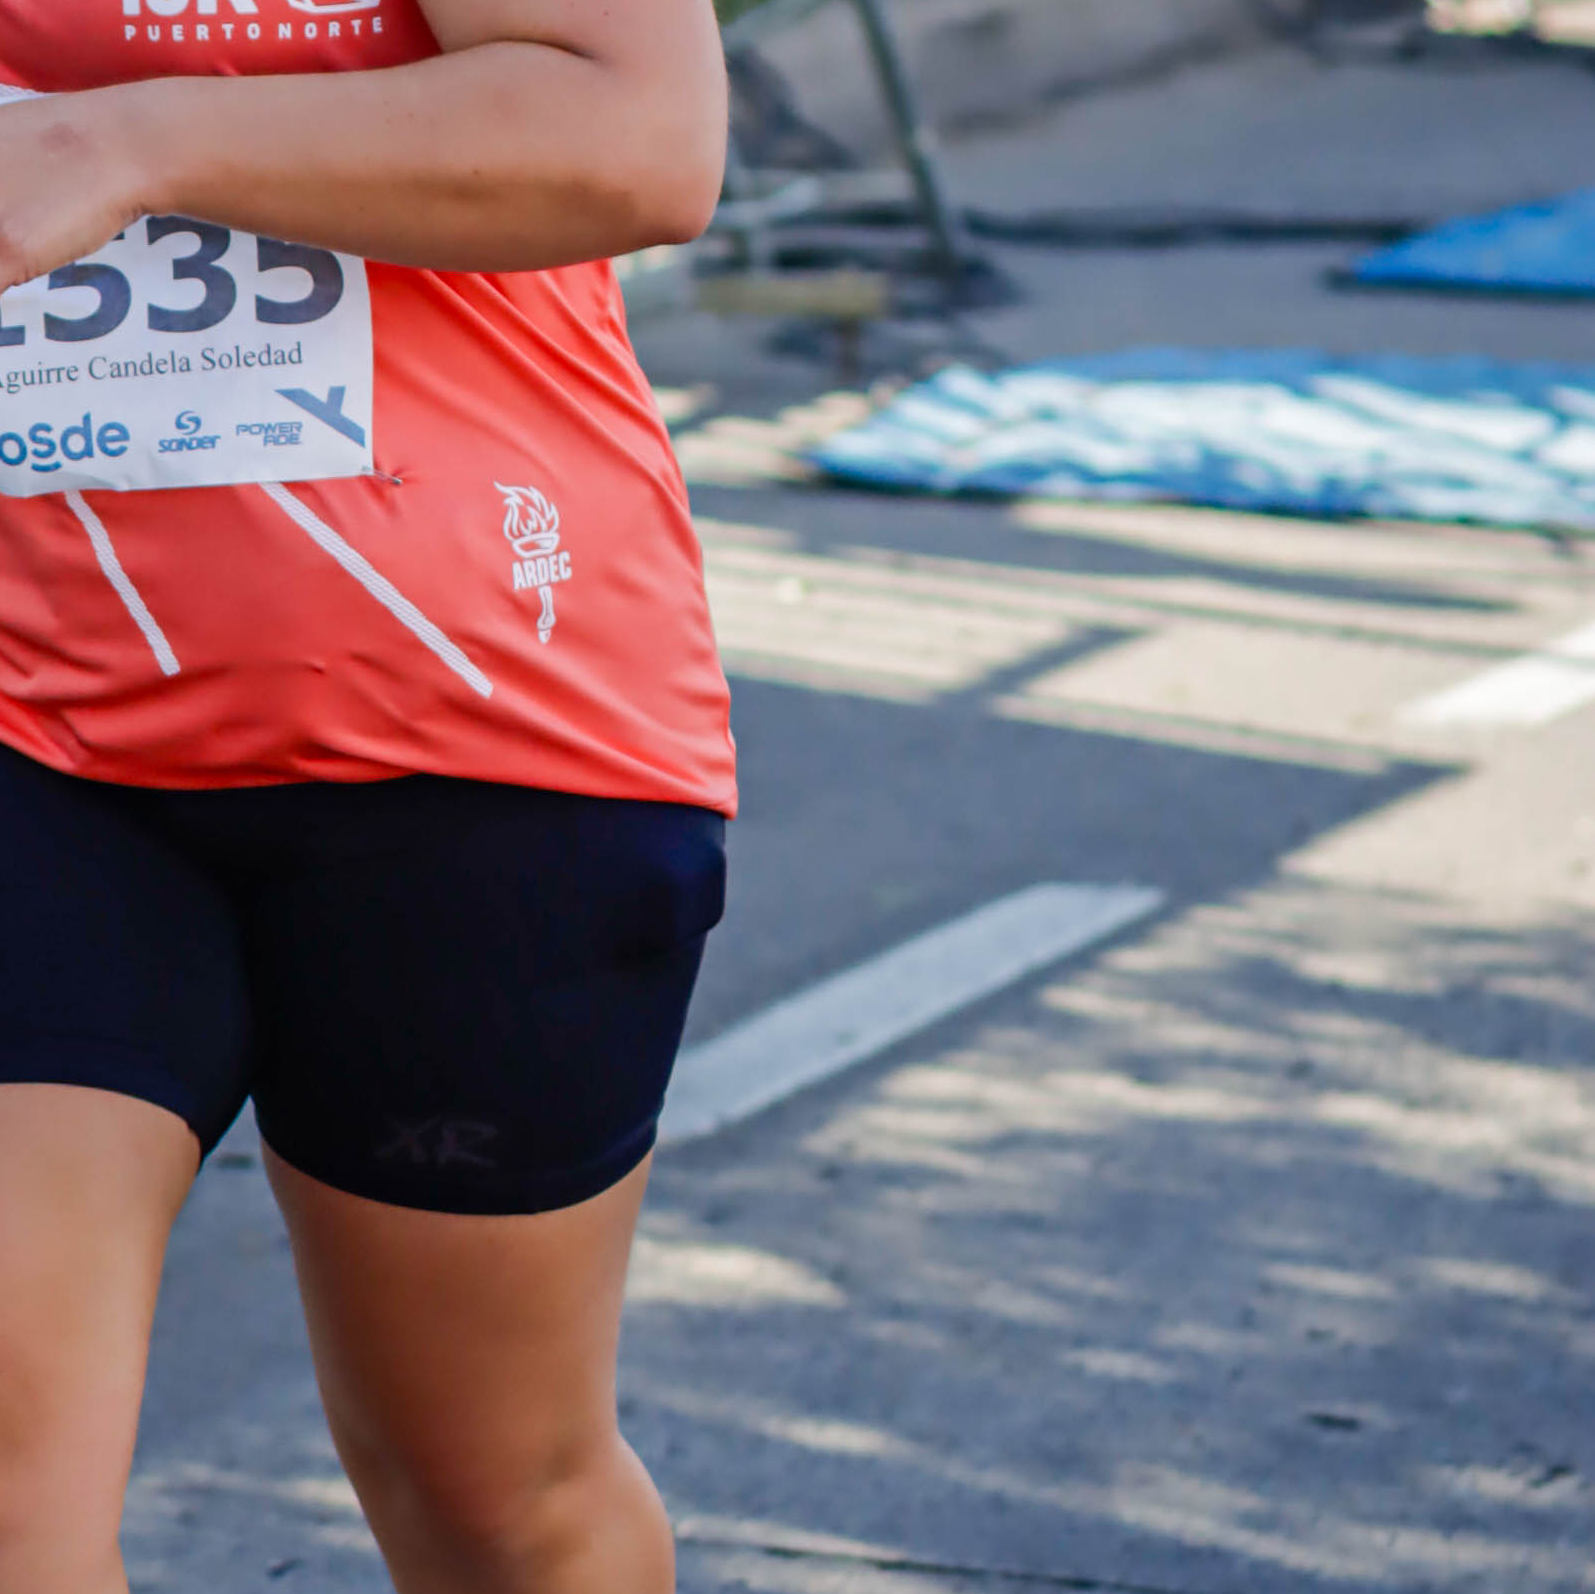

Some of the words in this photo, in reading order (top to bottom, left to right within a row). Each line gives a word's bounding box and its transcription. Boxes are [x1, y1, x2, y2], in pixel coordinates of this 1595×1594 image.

[124, 21, 262, 43] PUERTO
[277, 15, 384, 41] NORTE
[87, 350, 192, 381] Candela
[200, 340, 304, 372] Soledad
[235, 421, 303, 436] POWER
[511, 551, 573, 591] ARDEC
